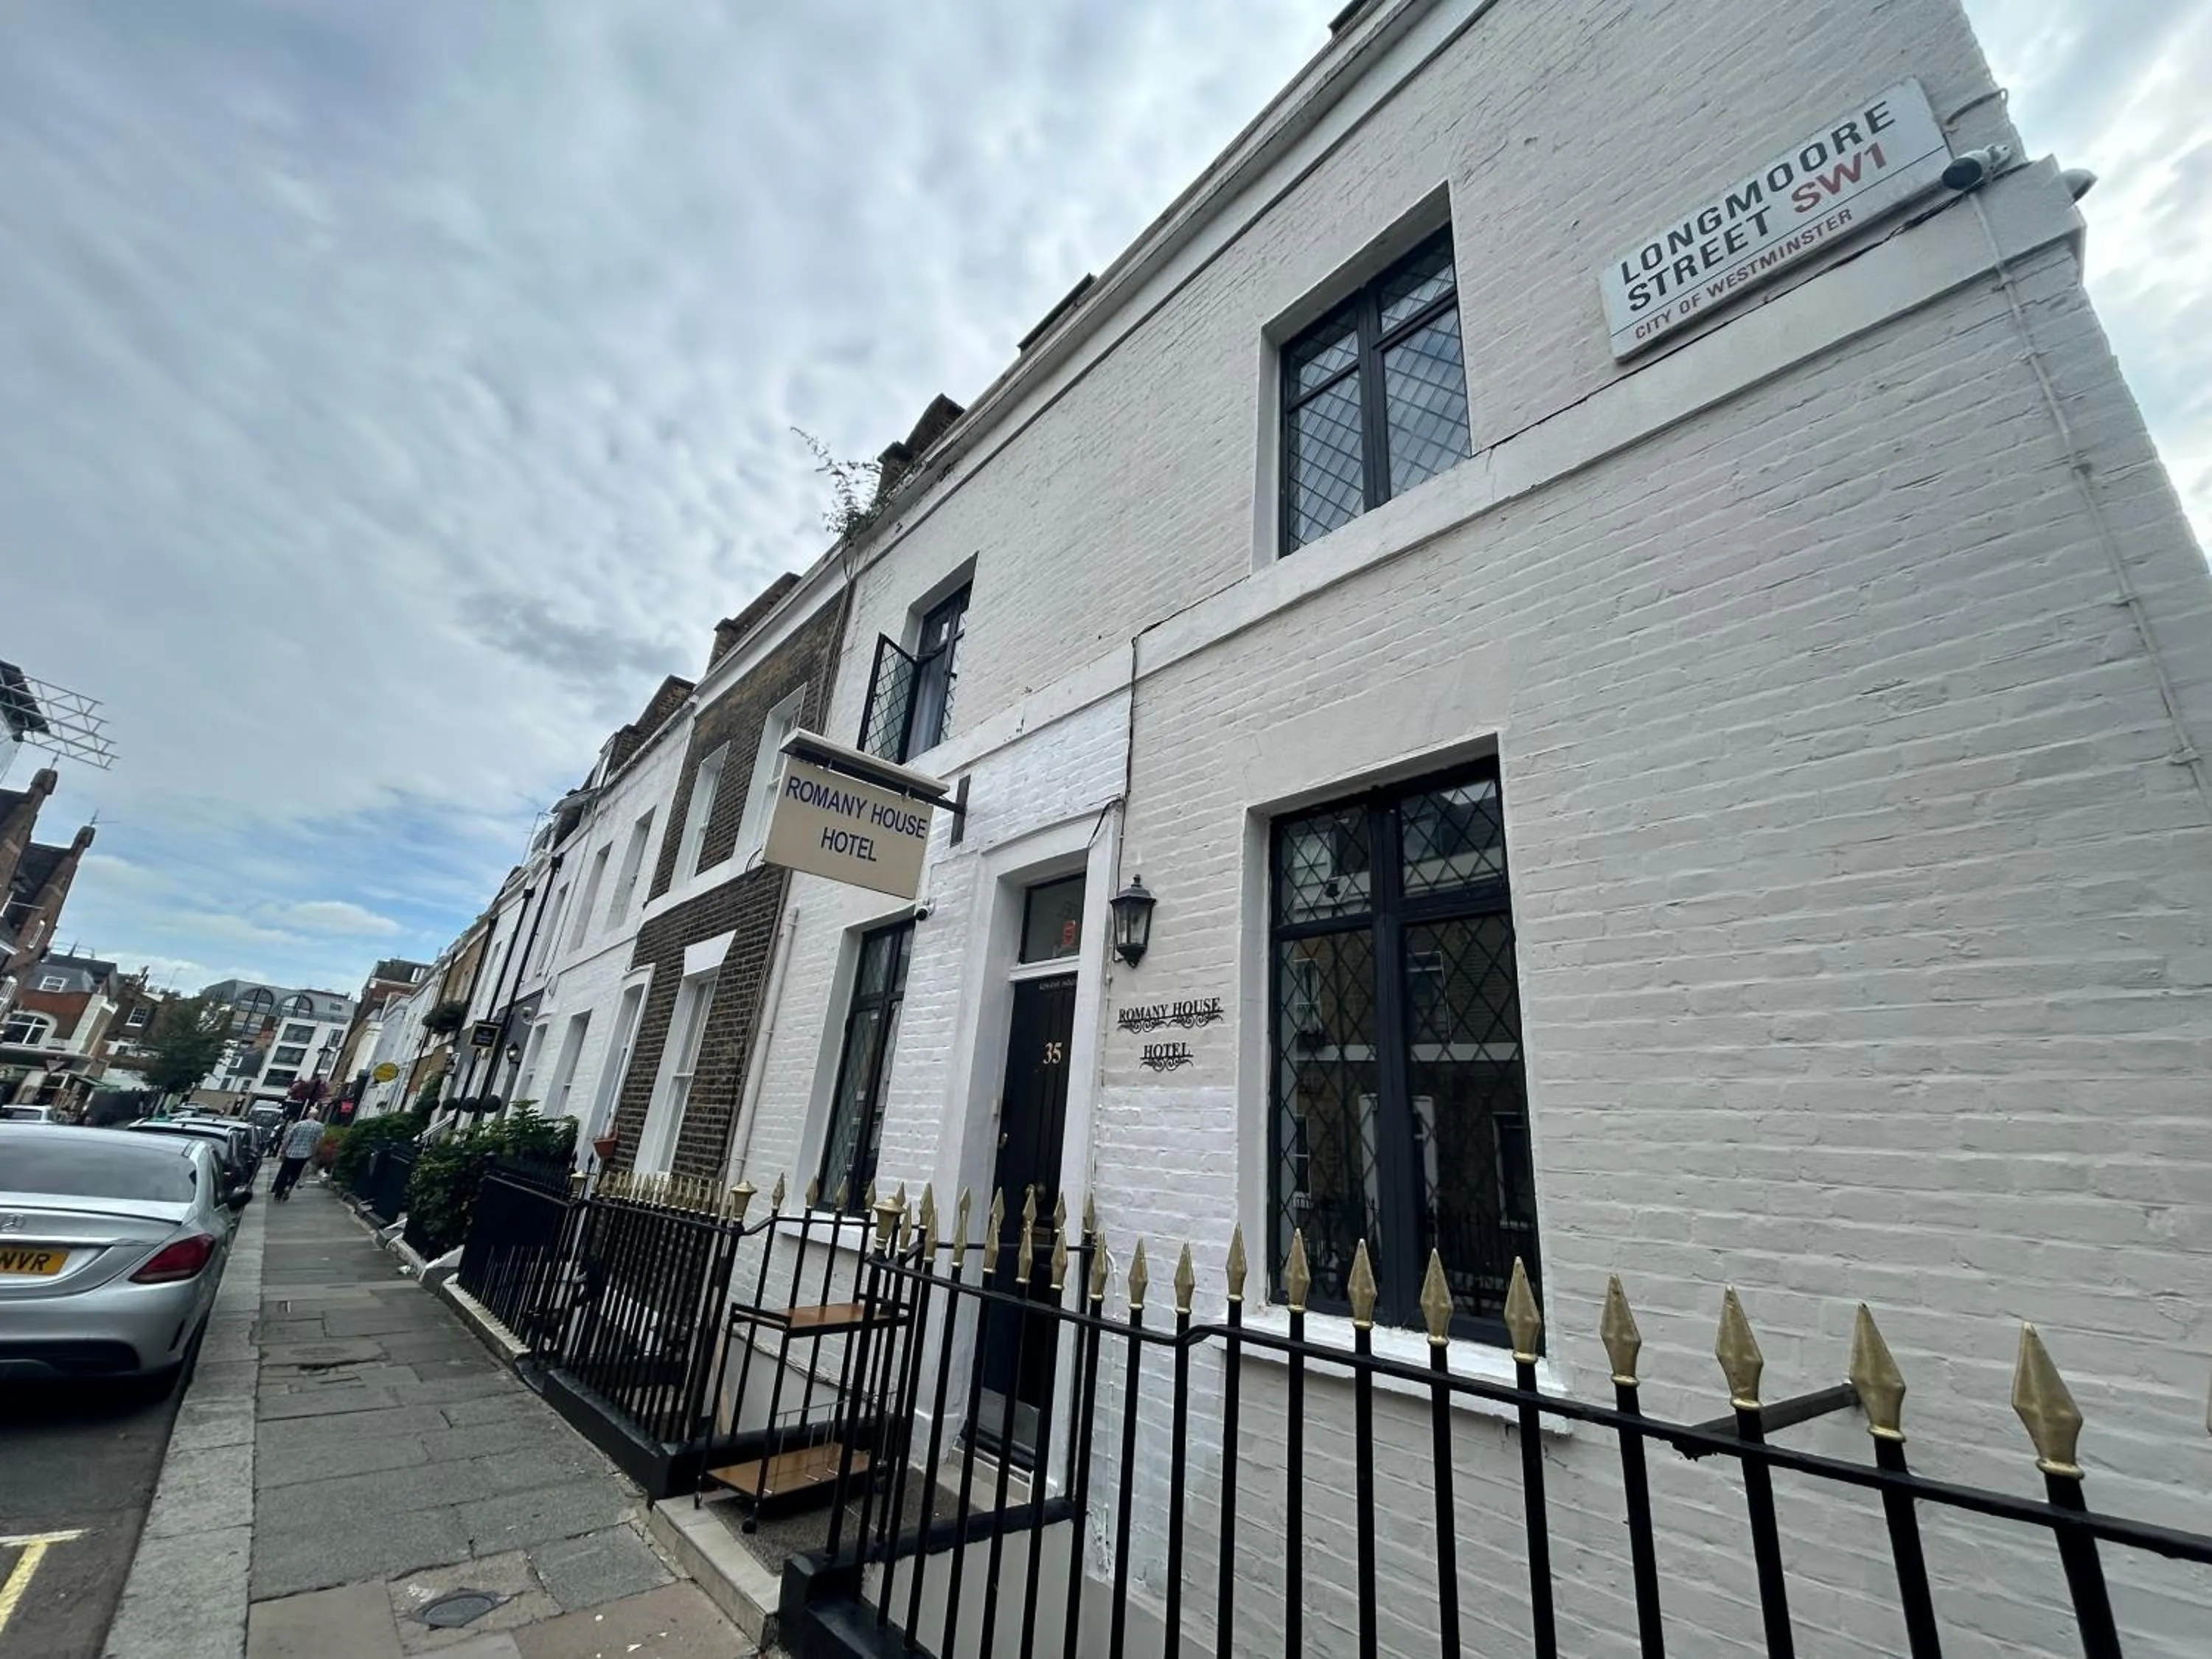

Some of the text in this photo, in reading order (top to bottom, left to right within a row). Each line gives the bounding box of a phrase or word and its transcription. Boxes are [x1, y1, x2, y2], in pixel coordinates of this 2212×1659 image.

[1621, 100, 1896, 285] LONGMOORE
[1627, 142, 1888, 311] STREET SW1
[1635, 209, 1854, 340] CITY OF WESTMINSTER
[785, 775, 928, 839] ROMANY HOUSE
[821, 827, 877, 862] HOTEL
[1119, 997, 1221, 1022] ROMANY HOUSE
[1042, 1041, 1062, 1064] 35
[1143, 1042, 1192, 1058] HOTEL
